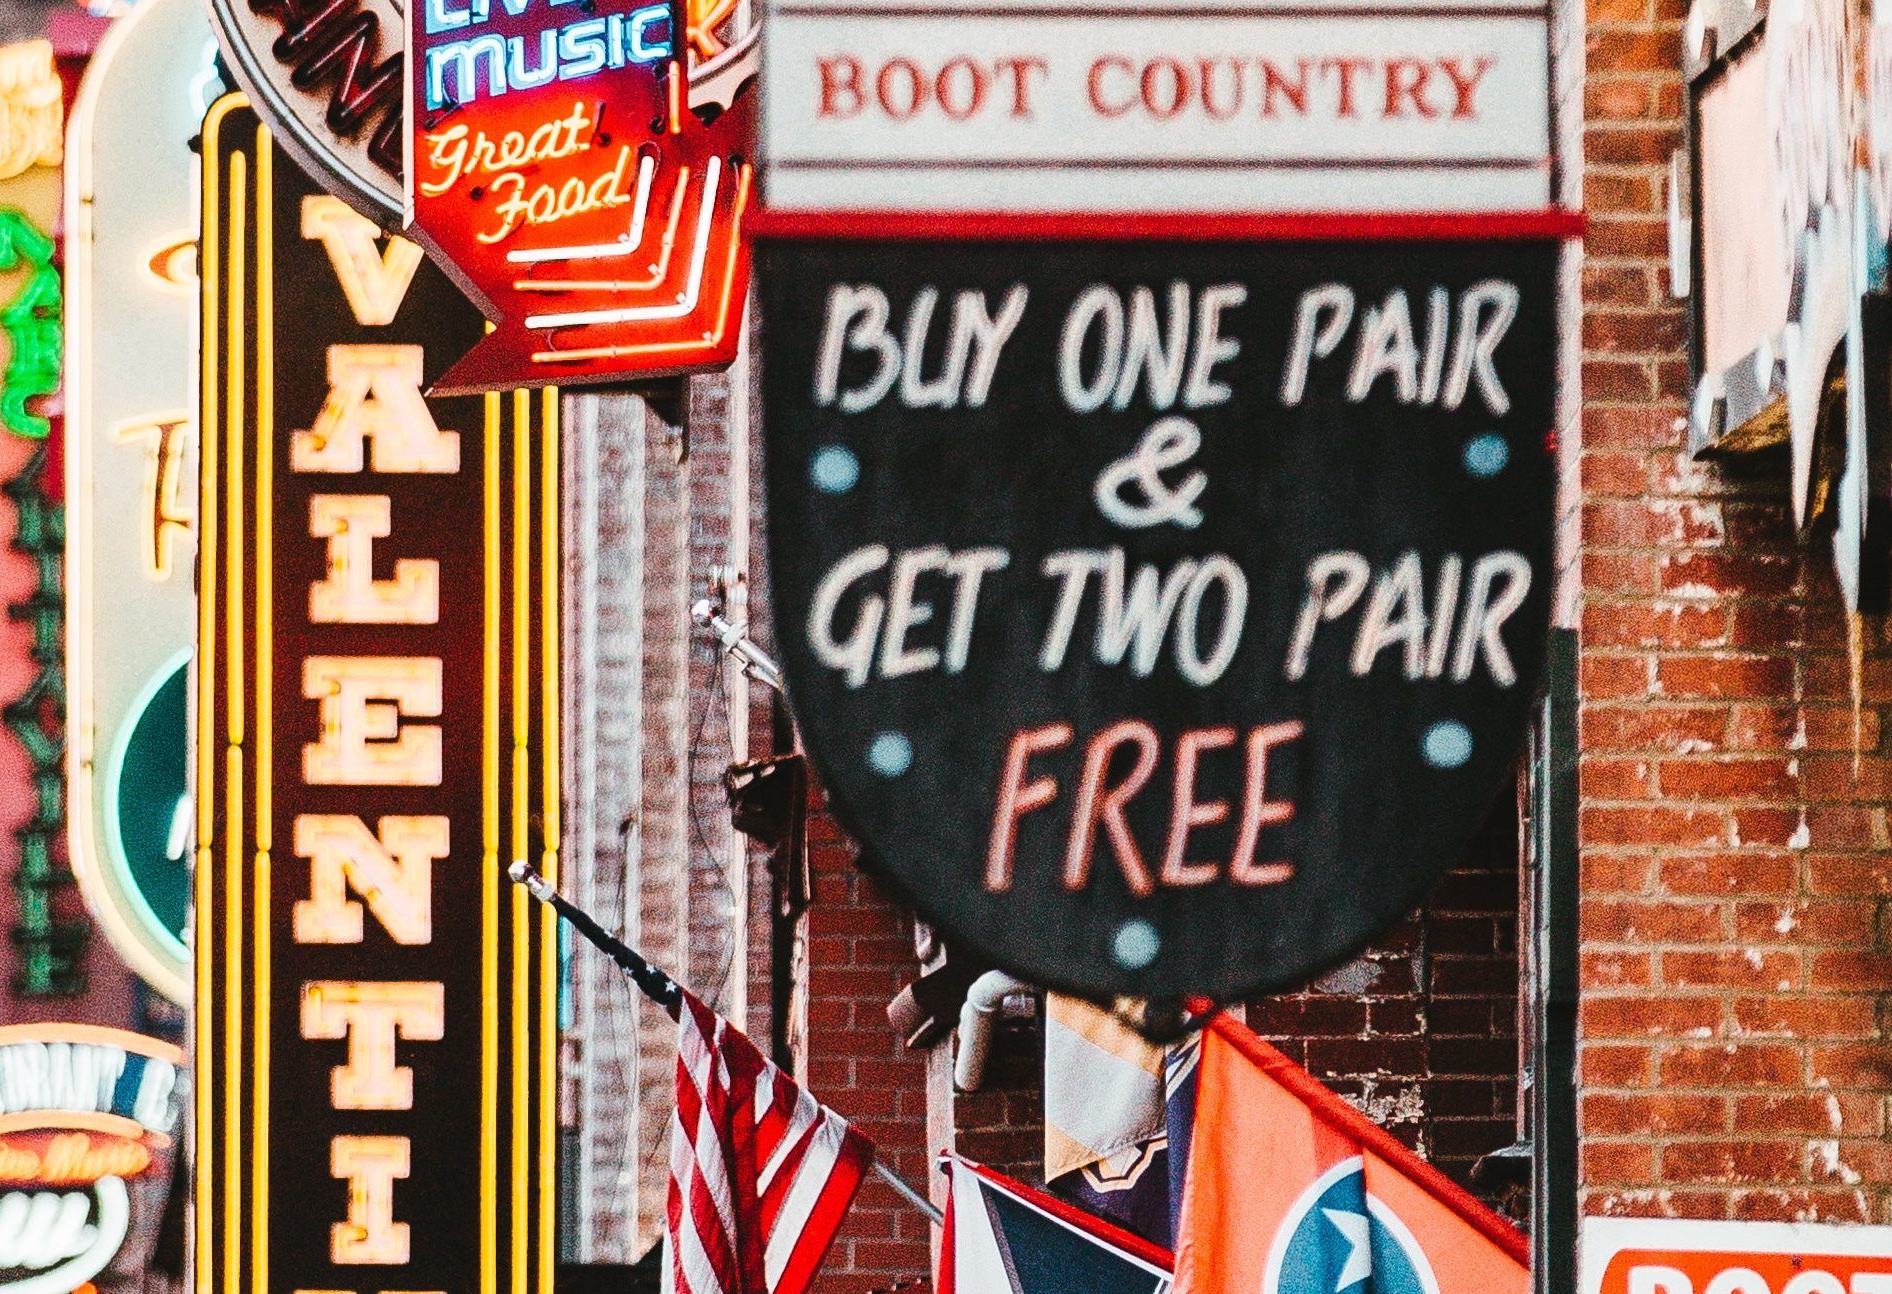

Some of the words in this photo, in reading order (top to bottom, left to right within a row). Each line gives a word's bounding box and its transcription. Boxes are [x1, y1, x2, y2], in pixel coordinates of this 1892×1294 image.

[426, 3, 673, 110] MUSIC
[816, 54, 1050, 121] BOOT
[1084, 54, 1496, 121] COUNTRY
[421, 101, 590, 195] Great
[477, 145, 632, 244] Food
[814, 283, 1029, 413] BUY
[1057, 281, 1248, 413] ONE
[1280, 278, 1521, 416] PAIR
[1094, 415, 1210, 530] &
[806, 544, 1010, 688] GET
[1038, 545, 1250, 688] TWO
[1286, 549, 1532, 687] PAIR
[983, 718, 1306, 898] FREE
